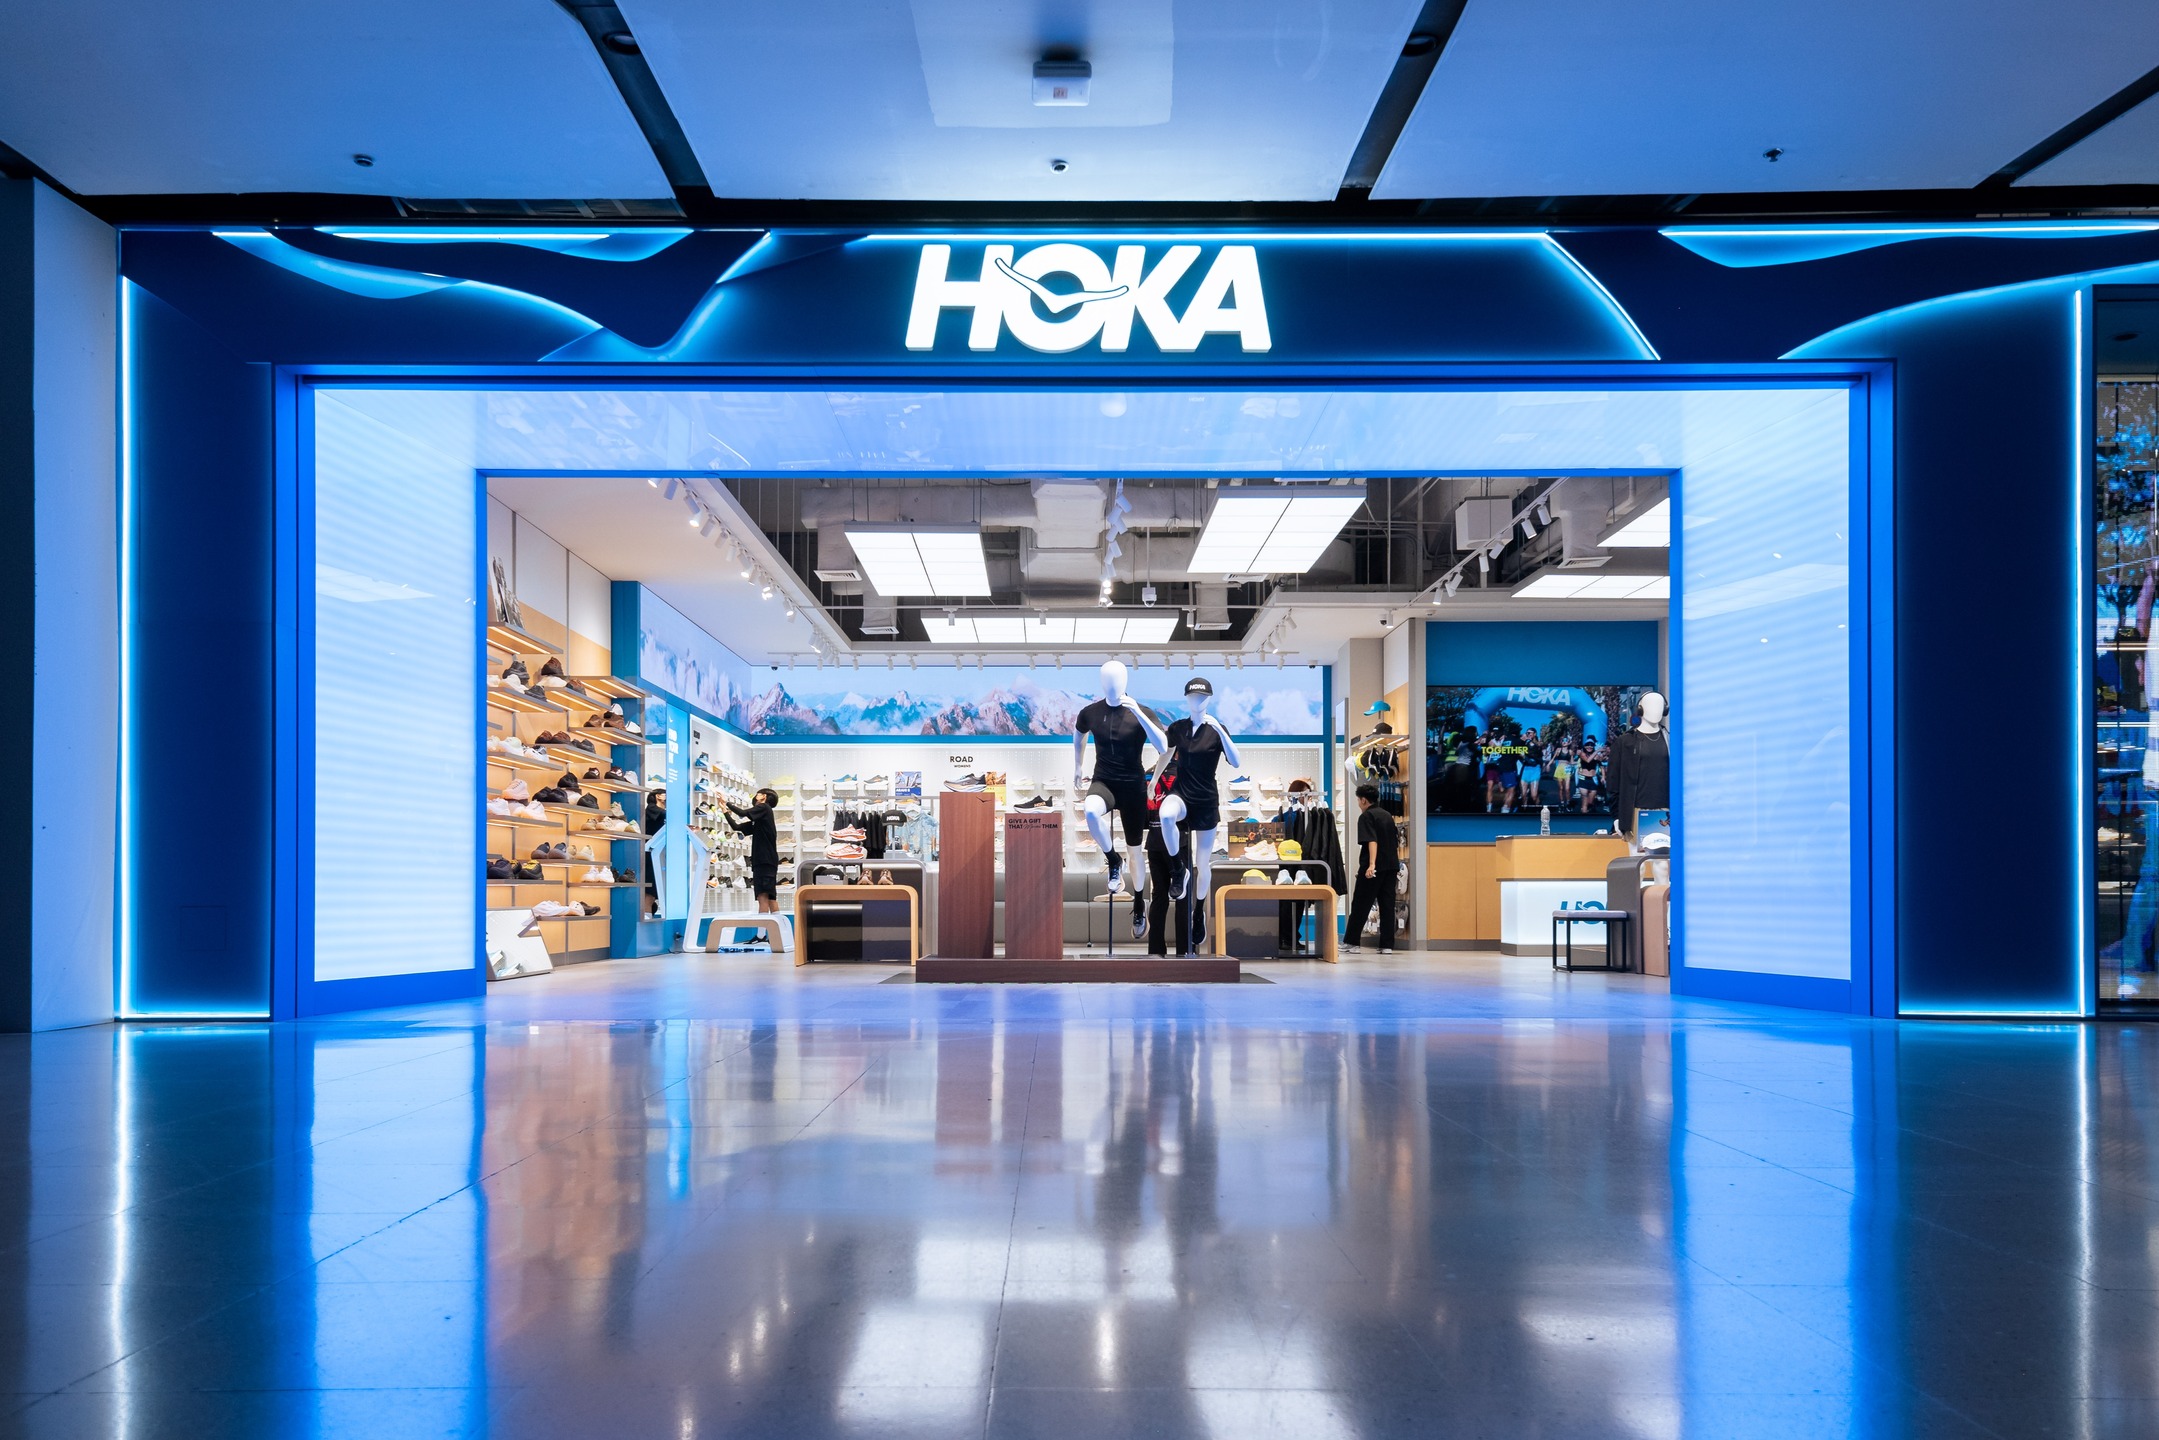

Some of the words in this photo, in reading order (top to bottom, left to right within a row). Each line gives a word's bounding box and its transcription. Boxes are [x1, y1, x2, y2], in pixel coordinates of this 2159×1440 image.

[905, 243, 1272, 354] HOKA
[1507, 687, 1570, 706] HOKA
[1481, 746, 1529, 755] TOGETHER
